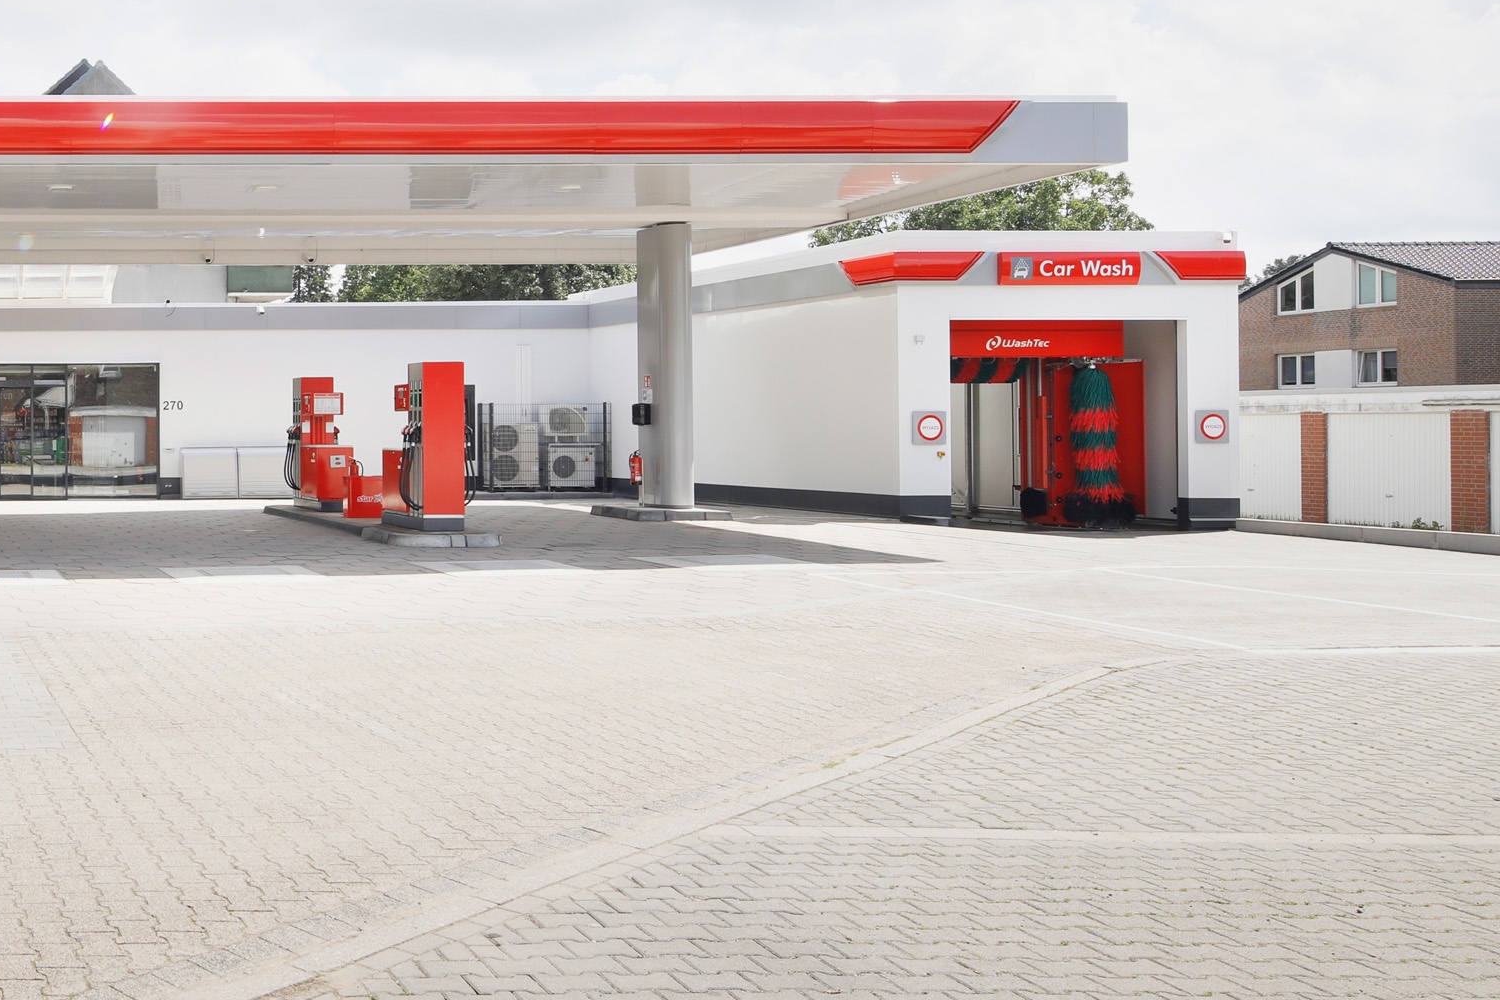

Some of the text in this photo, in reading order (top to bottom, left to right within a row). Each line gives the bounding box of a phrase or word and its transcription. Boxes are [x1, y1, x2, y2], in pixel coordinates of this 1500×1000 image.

[1039, 258, 1134, 277] Car Wash
[1002, 339, 1050, 348] WashTec
[163, 400, 184, 411] 270
